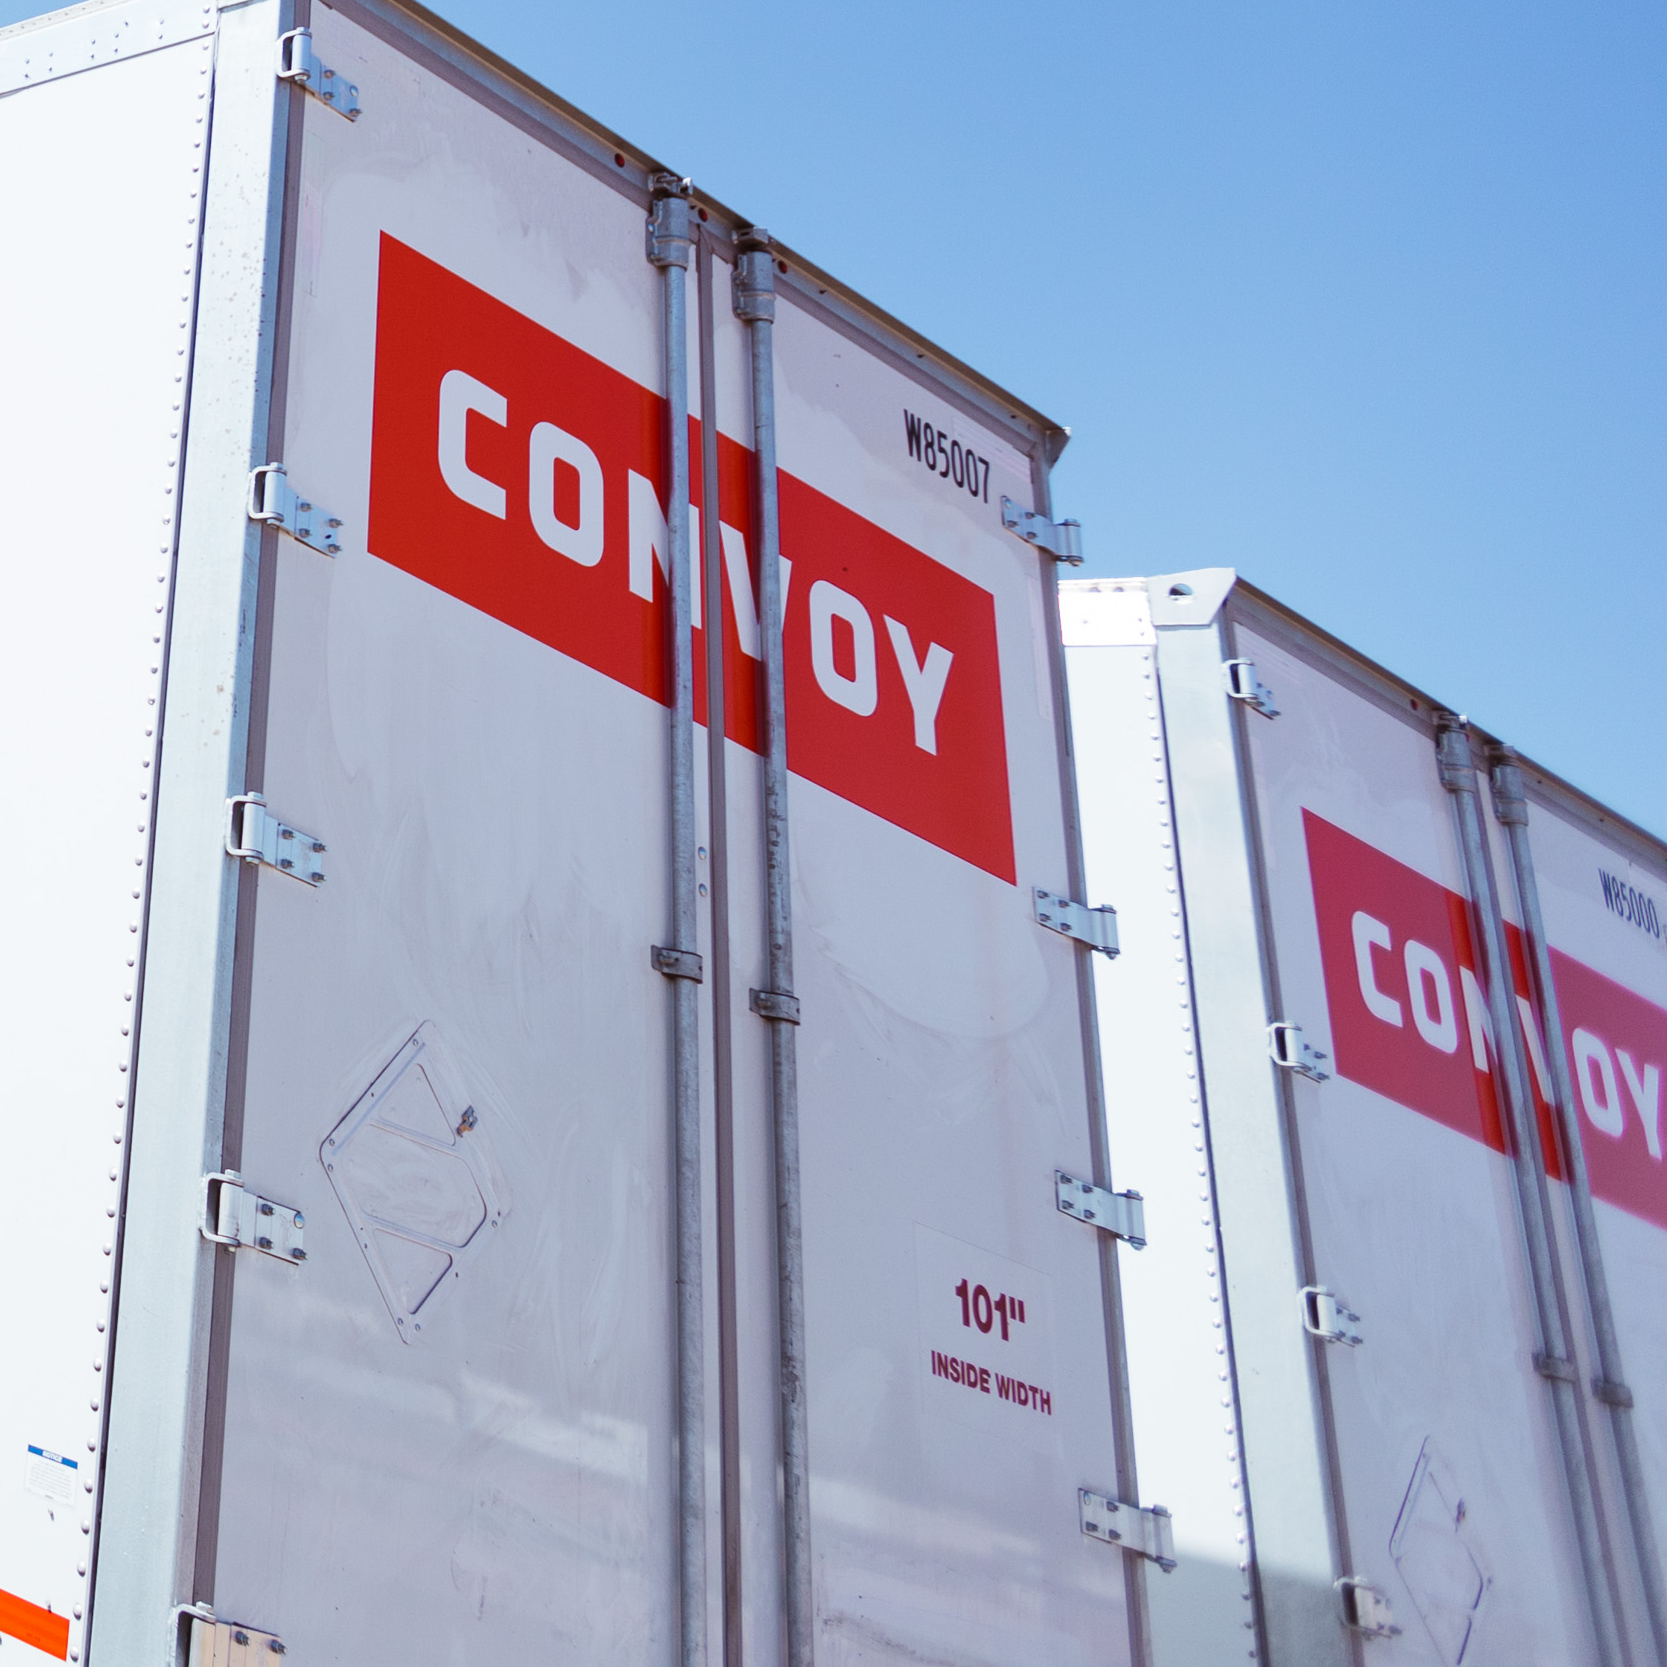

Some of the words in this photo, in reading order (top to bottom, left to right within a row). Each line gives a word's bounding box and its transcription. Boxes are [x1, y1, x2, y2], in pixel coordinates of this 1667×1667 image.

[903, 408, 991, 504] W85007
[1598, 868, 1660, 939] W85000
[955, 1278, 1026, 1342] 101"
[931, 1350, 992, 1395] INSIDE
[995, 1372, 1053, 1416] WIDTH
